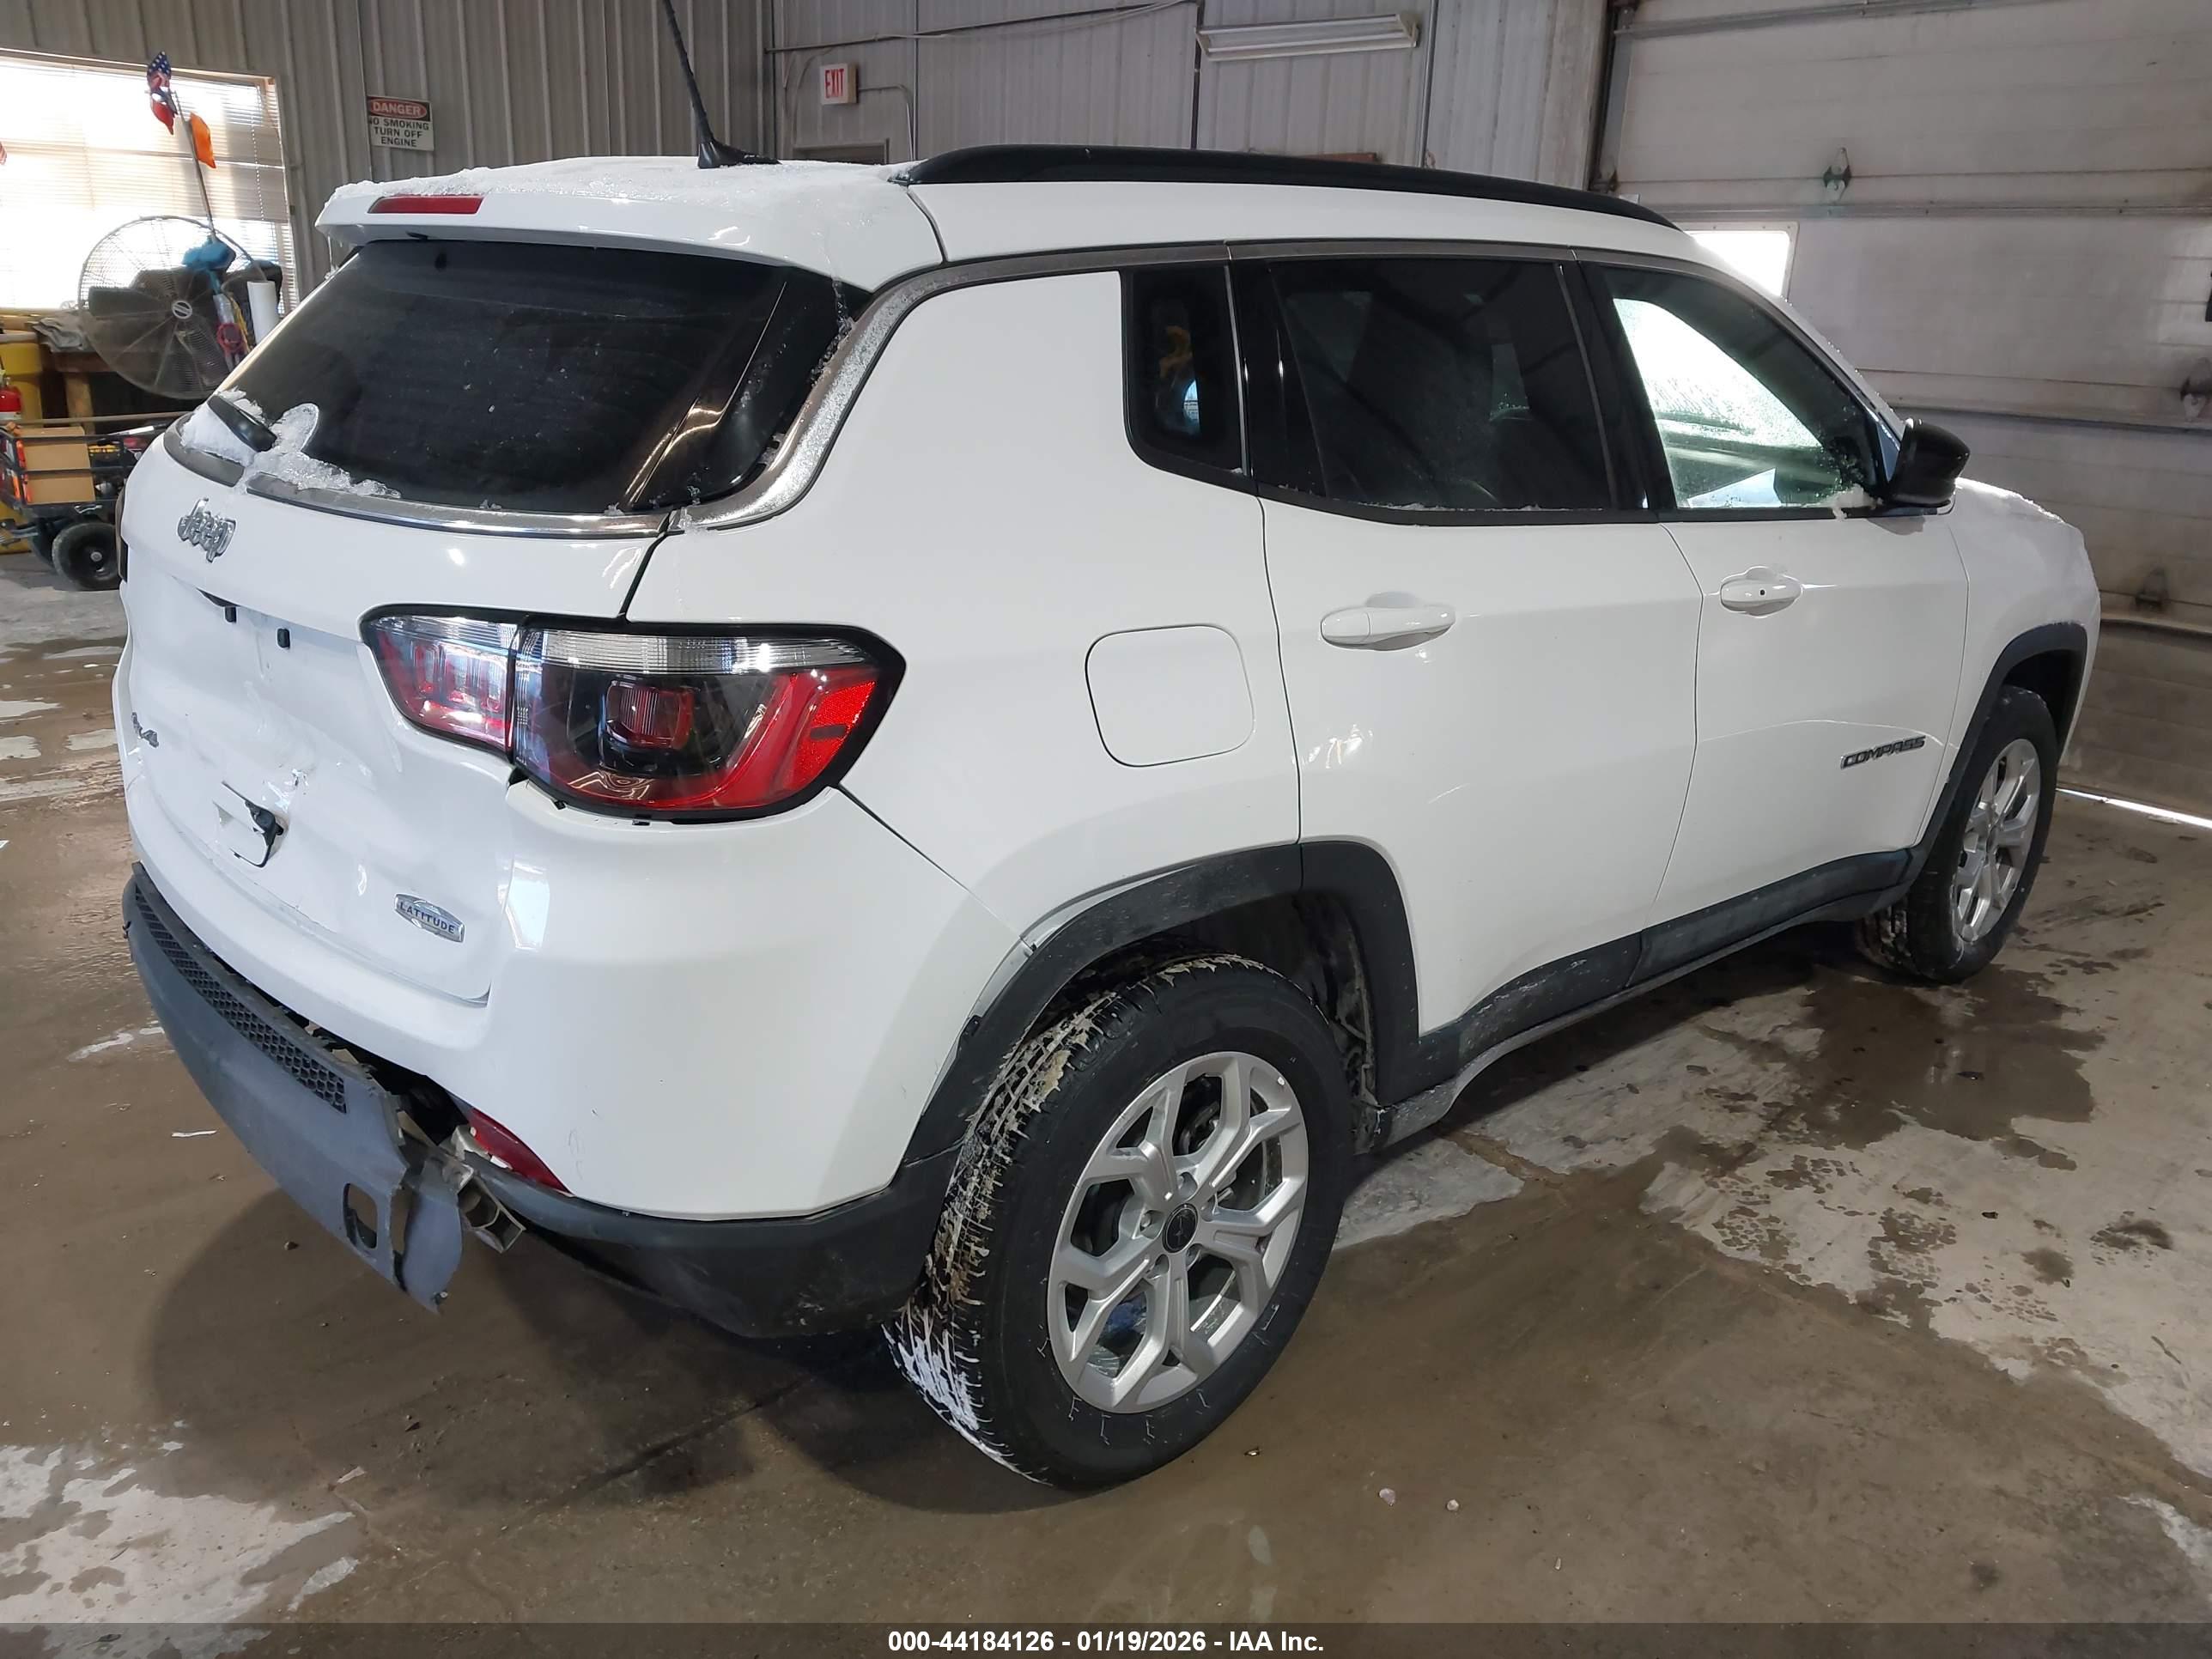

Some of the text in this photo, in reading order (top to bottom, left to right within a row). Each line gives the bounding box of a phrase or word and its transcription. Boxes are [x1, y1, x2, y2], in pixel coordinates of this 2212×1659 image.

[824, 69, 845, 99] EXIT
[373, 101, 422, 116] DANGER
[374, 126, 423, 138] TURN OFF
[383, 118, 429, 131] SMOKING
[380, 137, 417, 148] ENGINE
[177, 497, 236, 563] Jeep
[1840, 735, 1926, 769] COMPASS
[399, 902, 455, 934] LATITUDE
